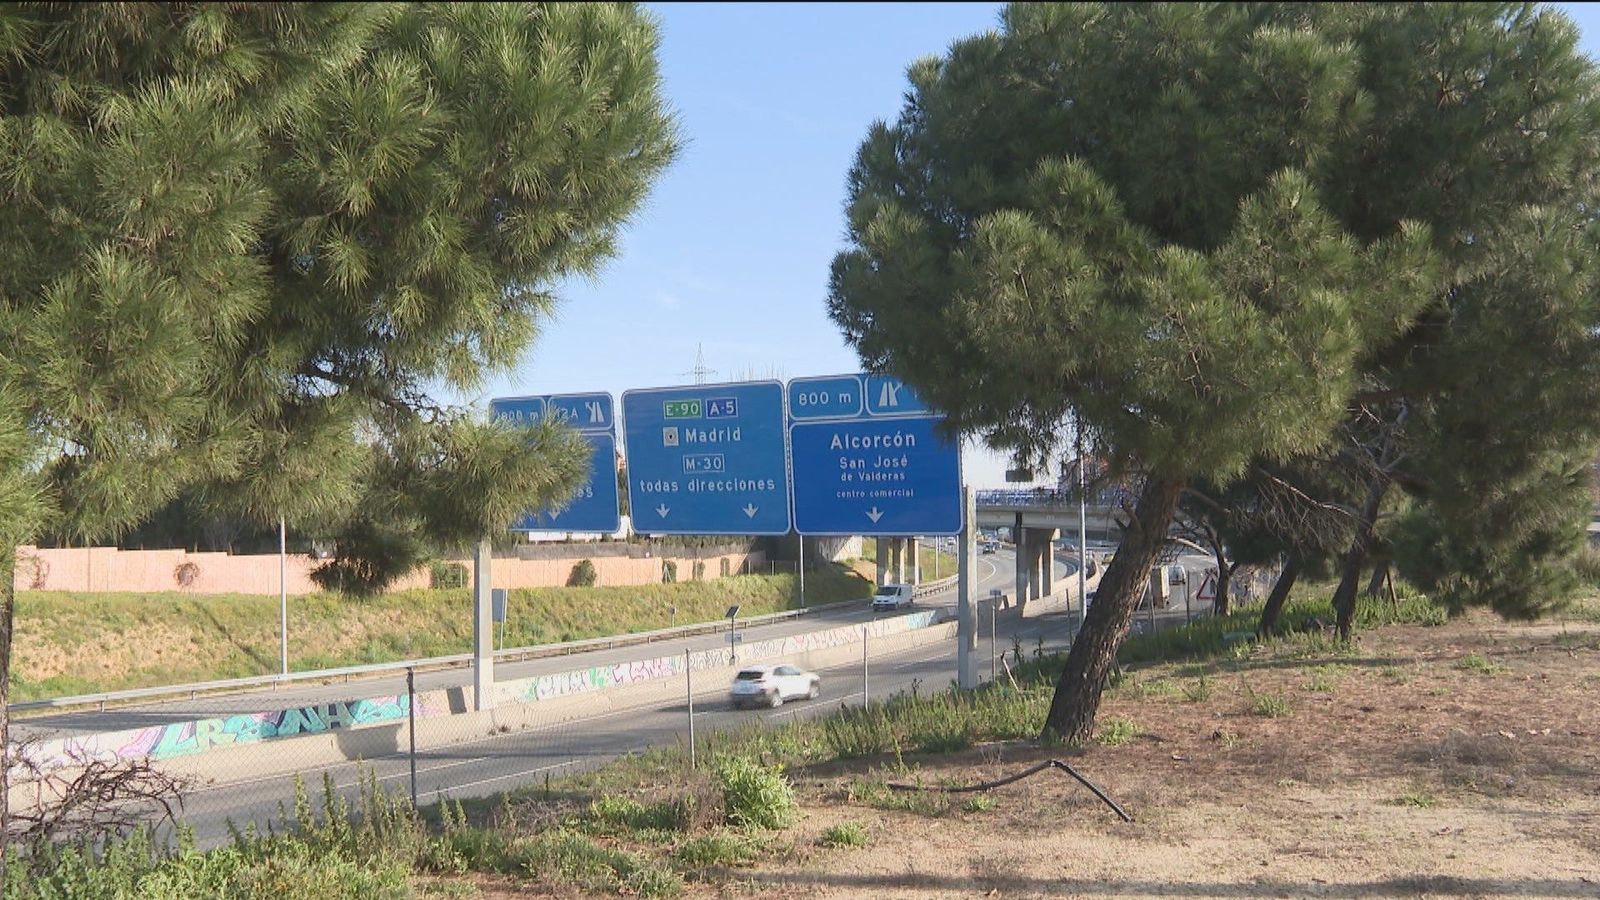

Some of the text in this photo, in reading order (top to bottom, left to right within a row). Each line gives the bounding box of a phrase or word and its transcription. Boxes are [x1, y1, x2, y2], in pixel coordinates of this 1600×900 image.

[798, 391, 852, 405] 800 m
[665, 402, 699, 416] E-90
[709, 401, 735, 416] A-5
[685, 426, 741, 443] Madrid
[830, 430, 916, 450] Alcorcón
[685, 457, 721, 470] M-30
[839, 454, 908, 470] San José
[840, 471, 905, 482] de Valderas
[640, 478, 775, 493] todas direcciones
[836, 488, 914, 498] centro comercial
